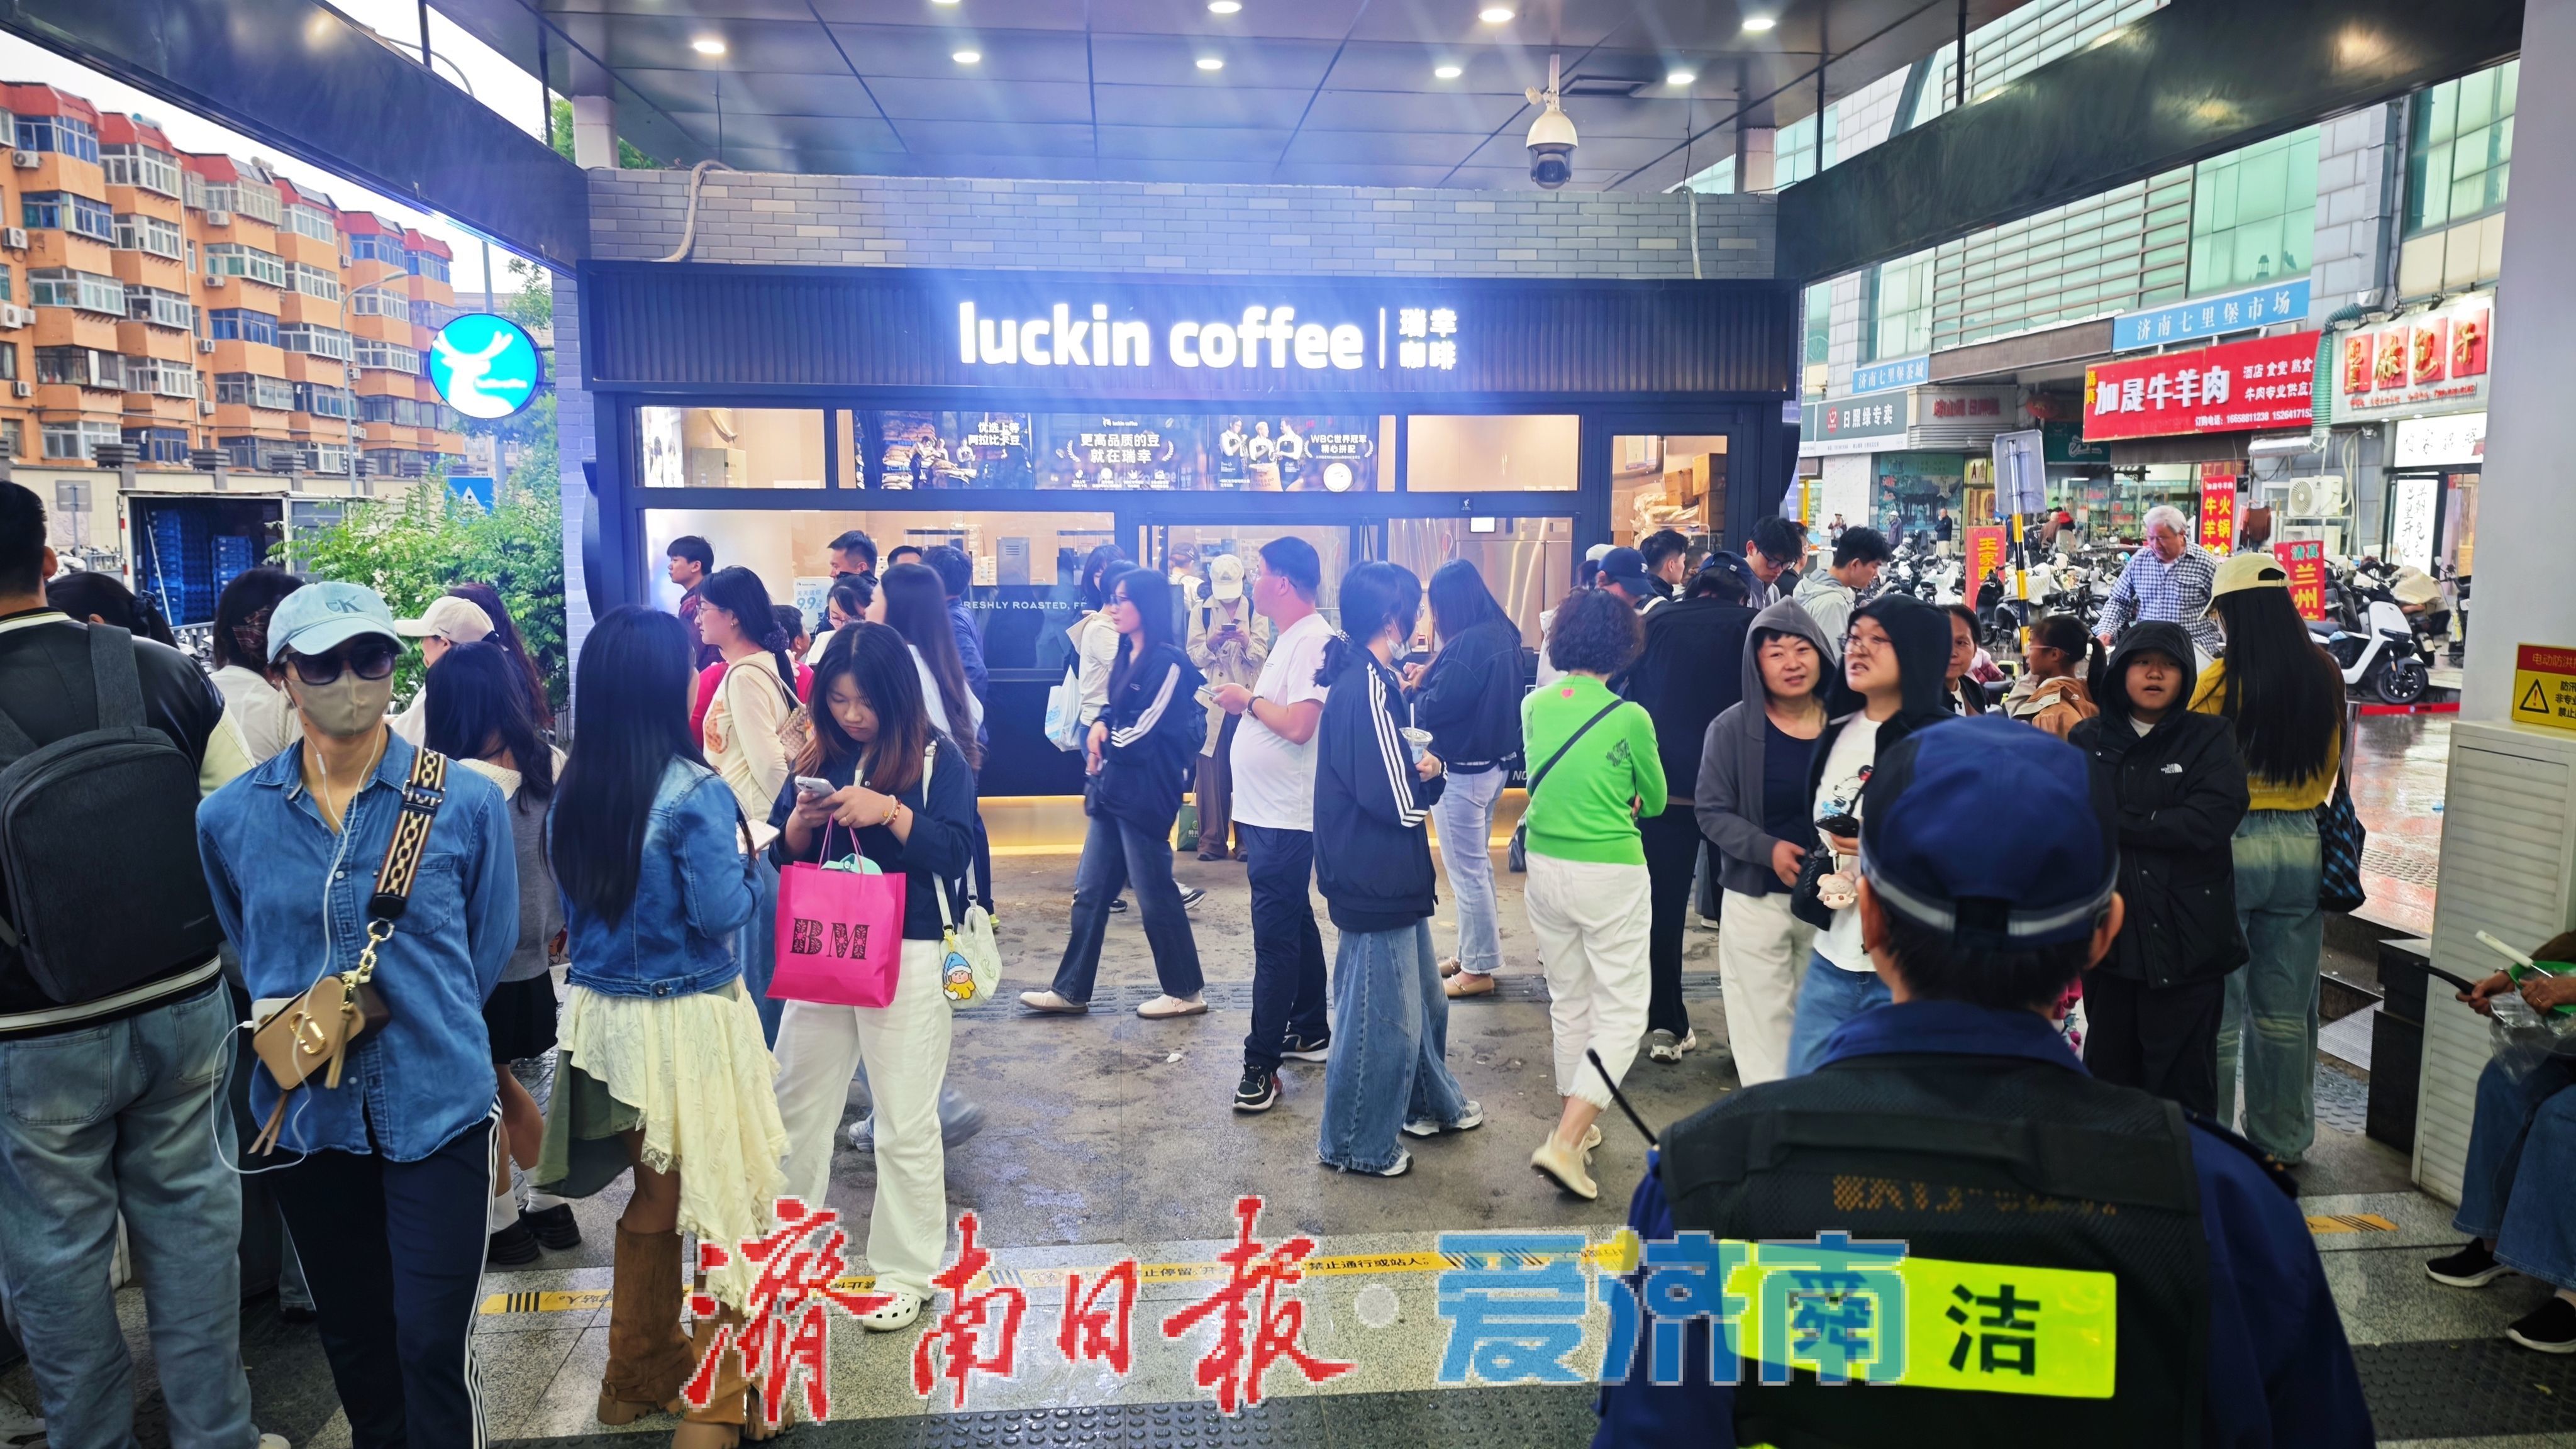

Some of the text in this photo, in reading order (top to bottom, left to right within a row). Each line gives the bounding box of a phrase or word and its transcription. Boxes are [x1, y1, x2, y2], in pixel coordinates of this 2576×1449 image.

[1399, 308, 1458, 338] 瑞幸
[2136, 291, 2290, 341] 济南七里堡市场
[959, 301, 1364, 369] luckin coffee
[1399, 341, 1458, 370] 咖啡
[1858, 361, 1925, 389] 济南七里堡茶城
[2243, 357, 2313, 379] 酒店 食堂 熟食
[2086, 370, 2097, 405] 清真
[2094, 365, 2231, 416] 加晟牛羊肉
[977, 421, 1020, 433] 优选上等
[1843, 403, 1893, 429] 日照绿专卖
[968, 434, 1021, 446] 阿拉比卡豆
[1080, 433, 1160, 447] 更高品质的豆
[1310, 434, 1367, 444] WBC世界冠军
[1321, 444, 1356, 453] 精心拼配
[1090, 448, 1152, 464] 就在瑞幸
[2290, 543, 2319, 561] 清真
[1013, 602, 1070, 610] ROASTED,
[2558, 707, 2576, 719] 禁止
[789, 918, 871, 960] BM
